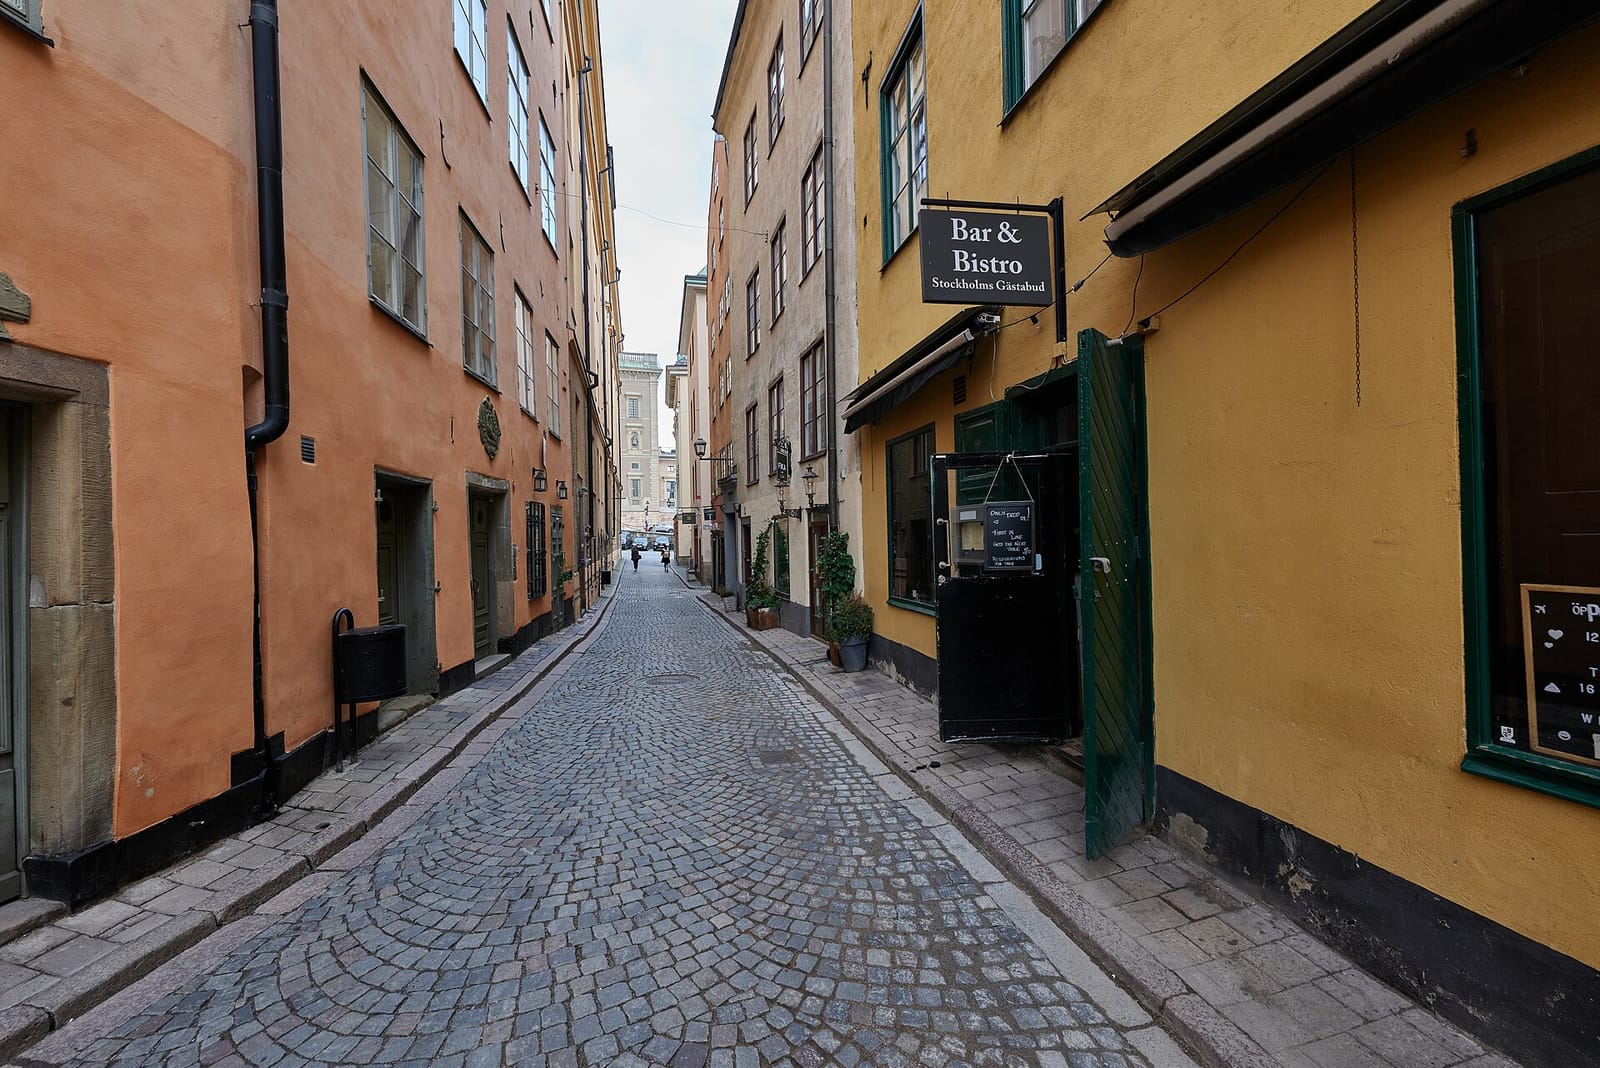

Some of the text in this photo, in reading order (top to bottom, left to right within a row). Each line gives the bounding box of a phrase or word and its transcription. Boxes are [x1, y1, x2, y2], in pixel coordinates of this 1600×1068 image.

[950, 218, 1022, 244] Bar &
[952, 249, 1022, 274] Bistro
[932, 277, 1045, 292] Stockholms Gästabud
[1571, 602, 1600, 622] ÖPP
